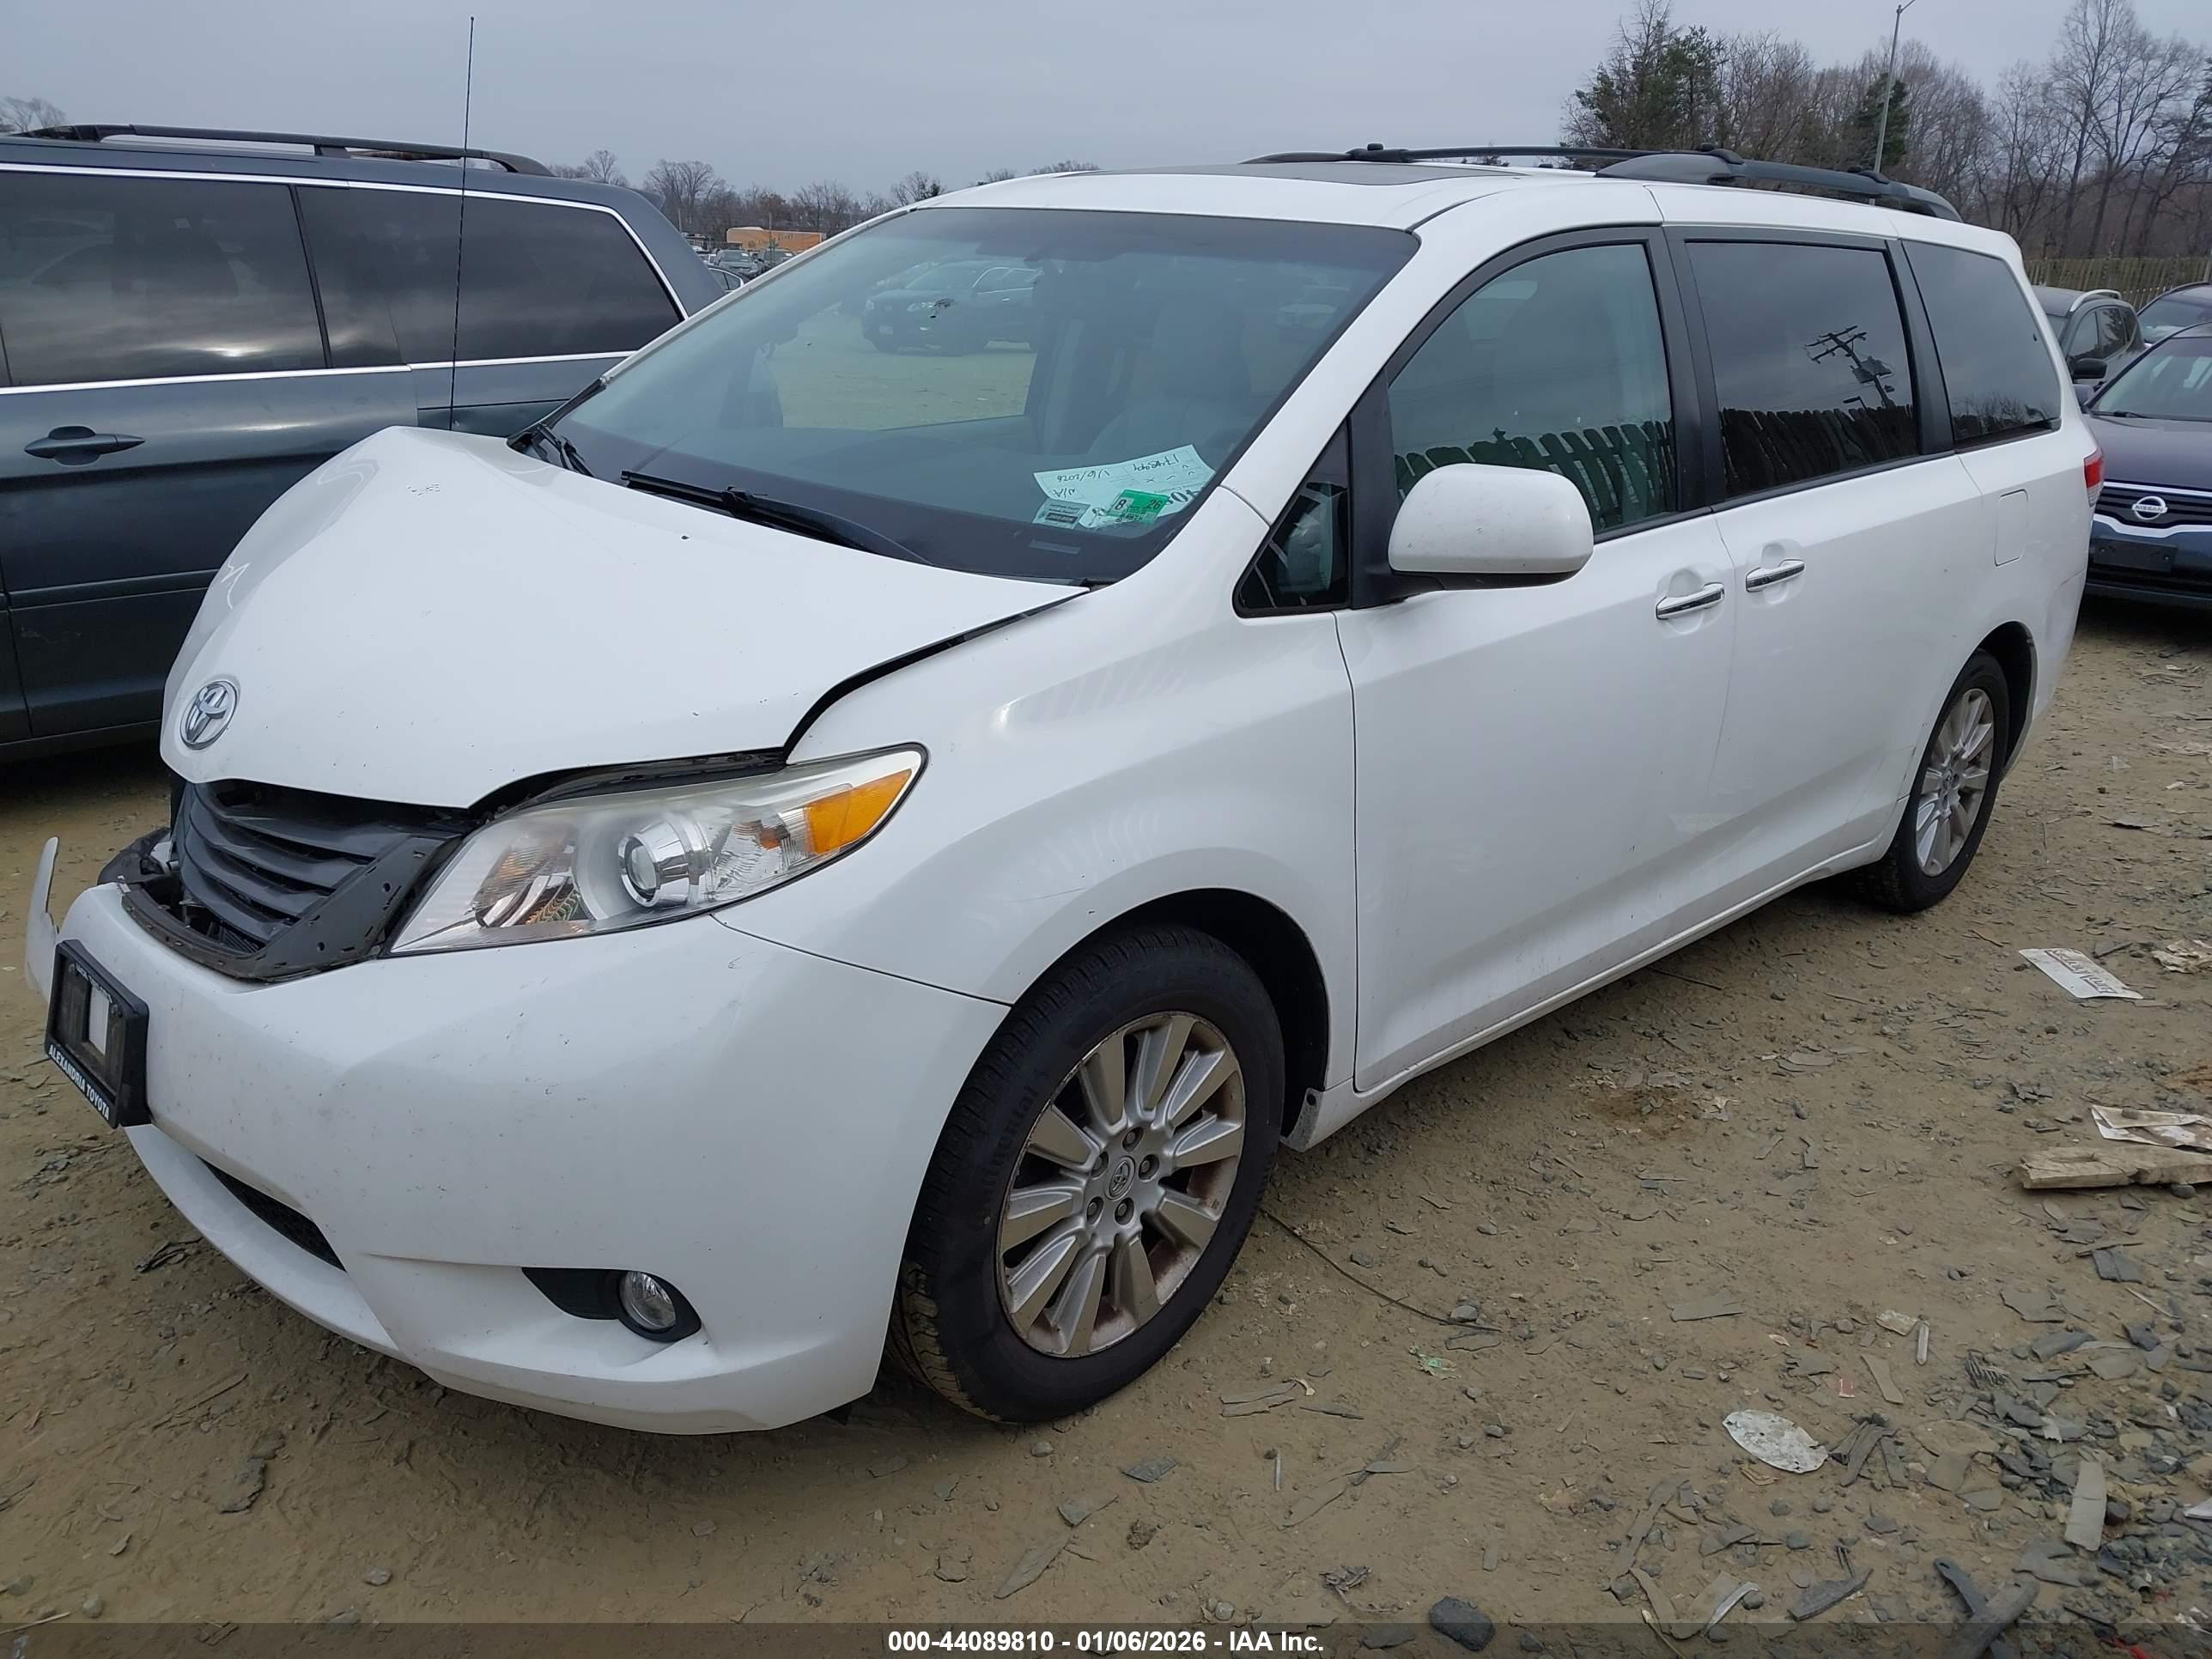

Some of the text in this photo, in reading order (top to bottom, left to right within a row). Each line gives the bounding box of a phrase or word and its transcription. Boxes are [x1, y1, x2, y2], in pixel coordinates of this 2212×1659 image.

[1115, 499, 1127, 510] 8
[1146, 499, 1163, 510] 26
[49, 1044, 110, 1121] ALEXANDRIA TOYOTA
